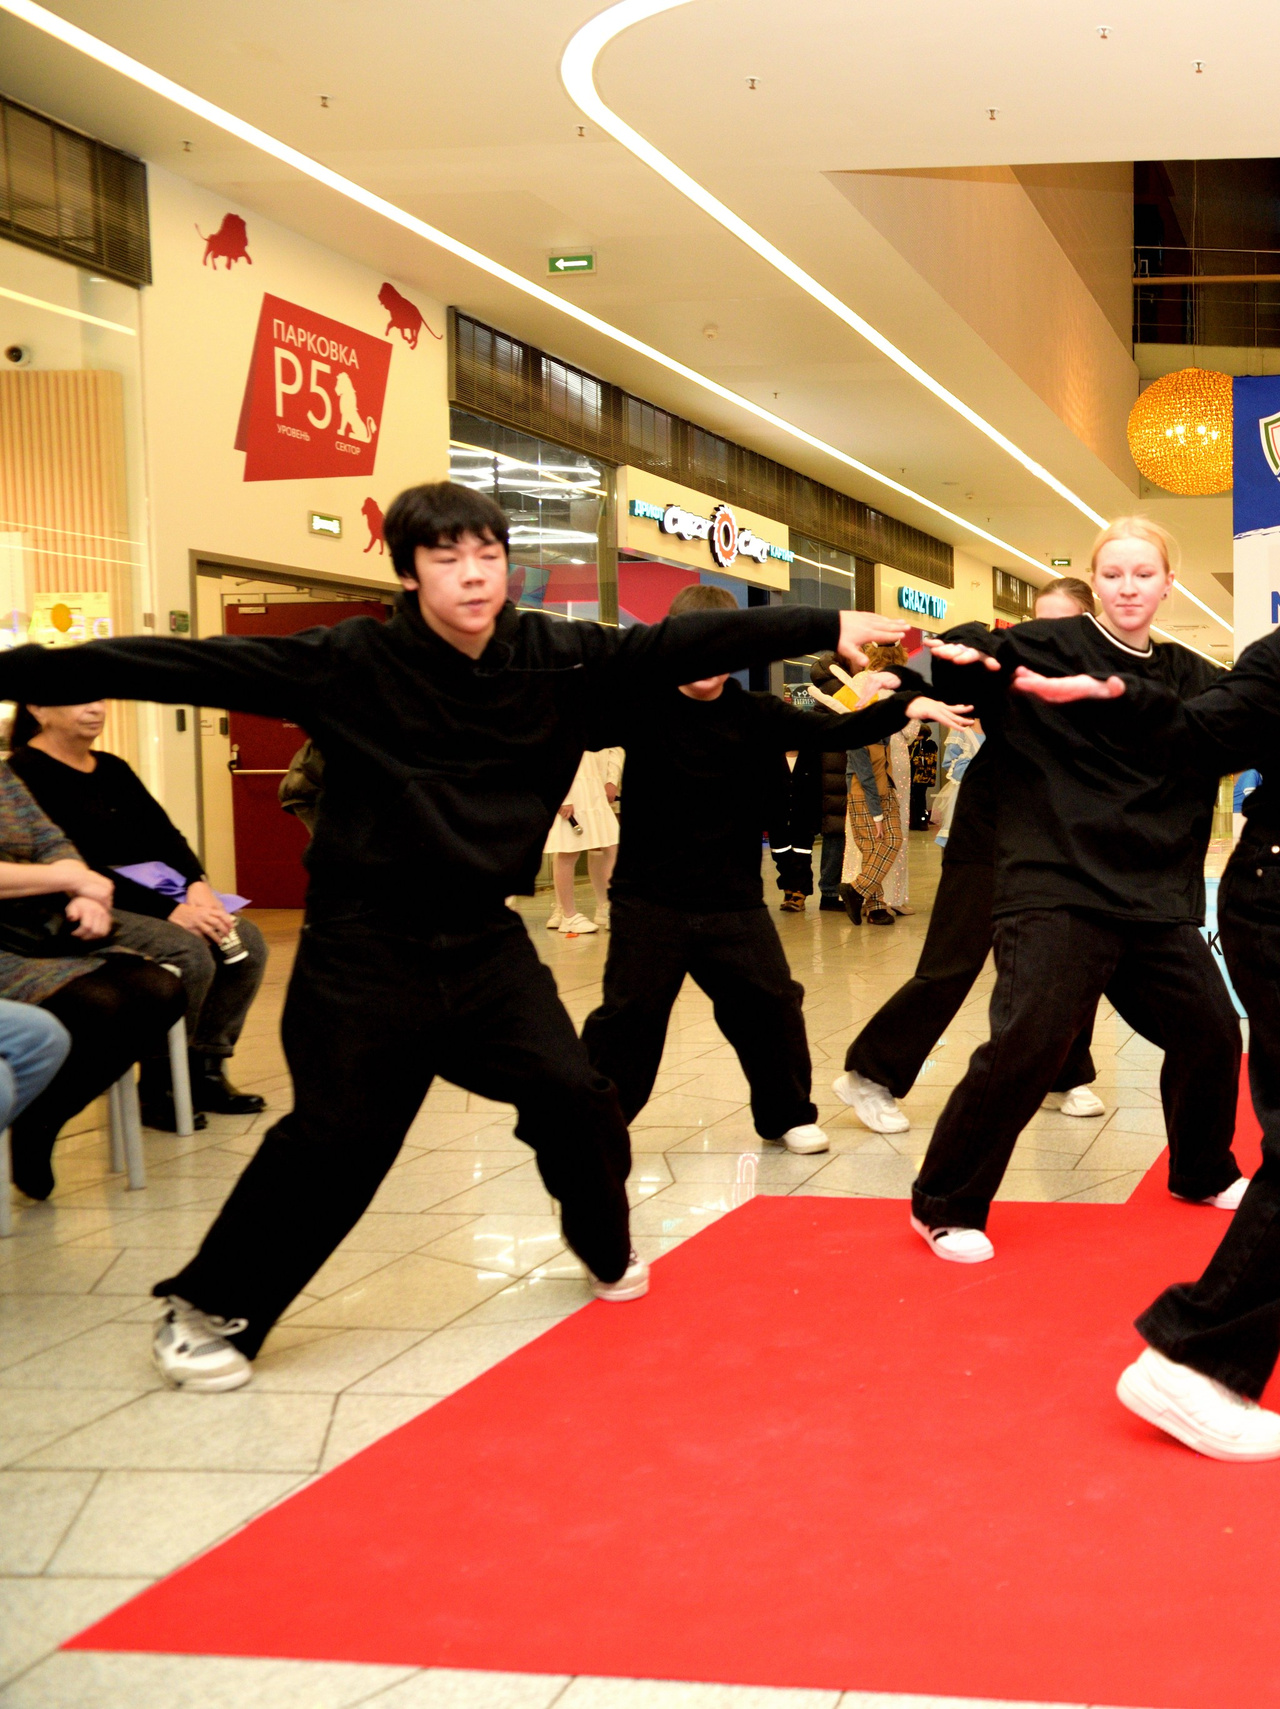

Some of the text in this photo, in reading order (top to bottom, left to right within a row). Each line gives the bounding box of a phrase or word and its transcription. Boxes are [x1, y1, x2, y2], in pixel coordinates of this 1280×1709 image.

[273, 318, 360, 370] ПАРКОВКА
[276, 423, 311, 442] УРОВЕНЬ
[335, 441, 361, 455] СЕКТОР
[900, 586, 948, 619] CRAZY ТИР
